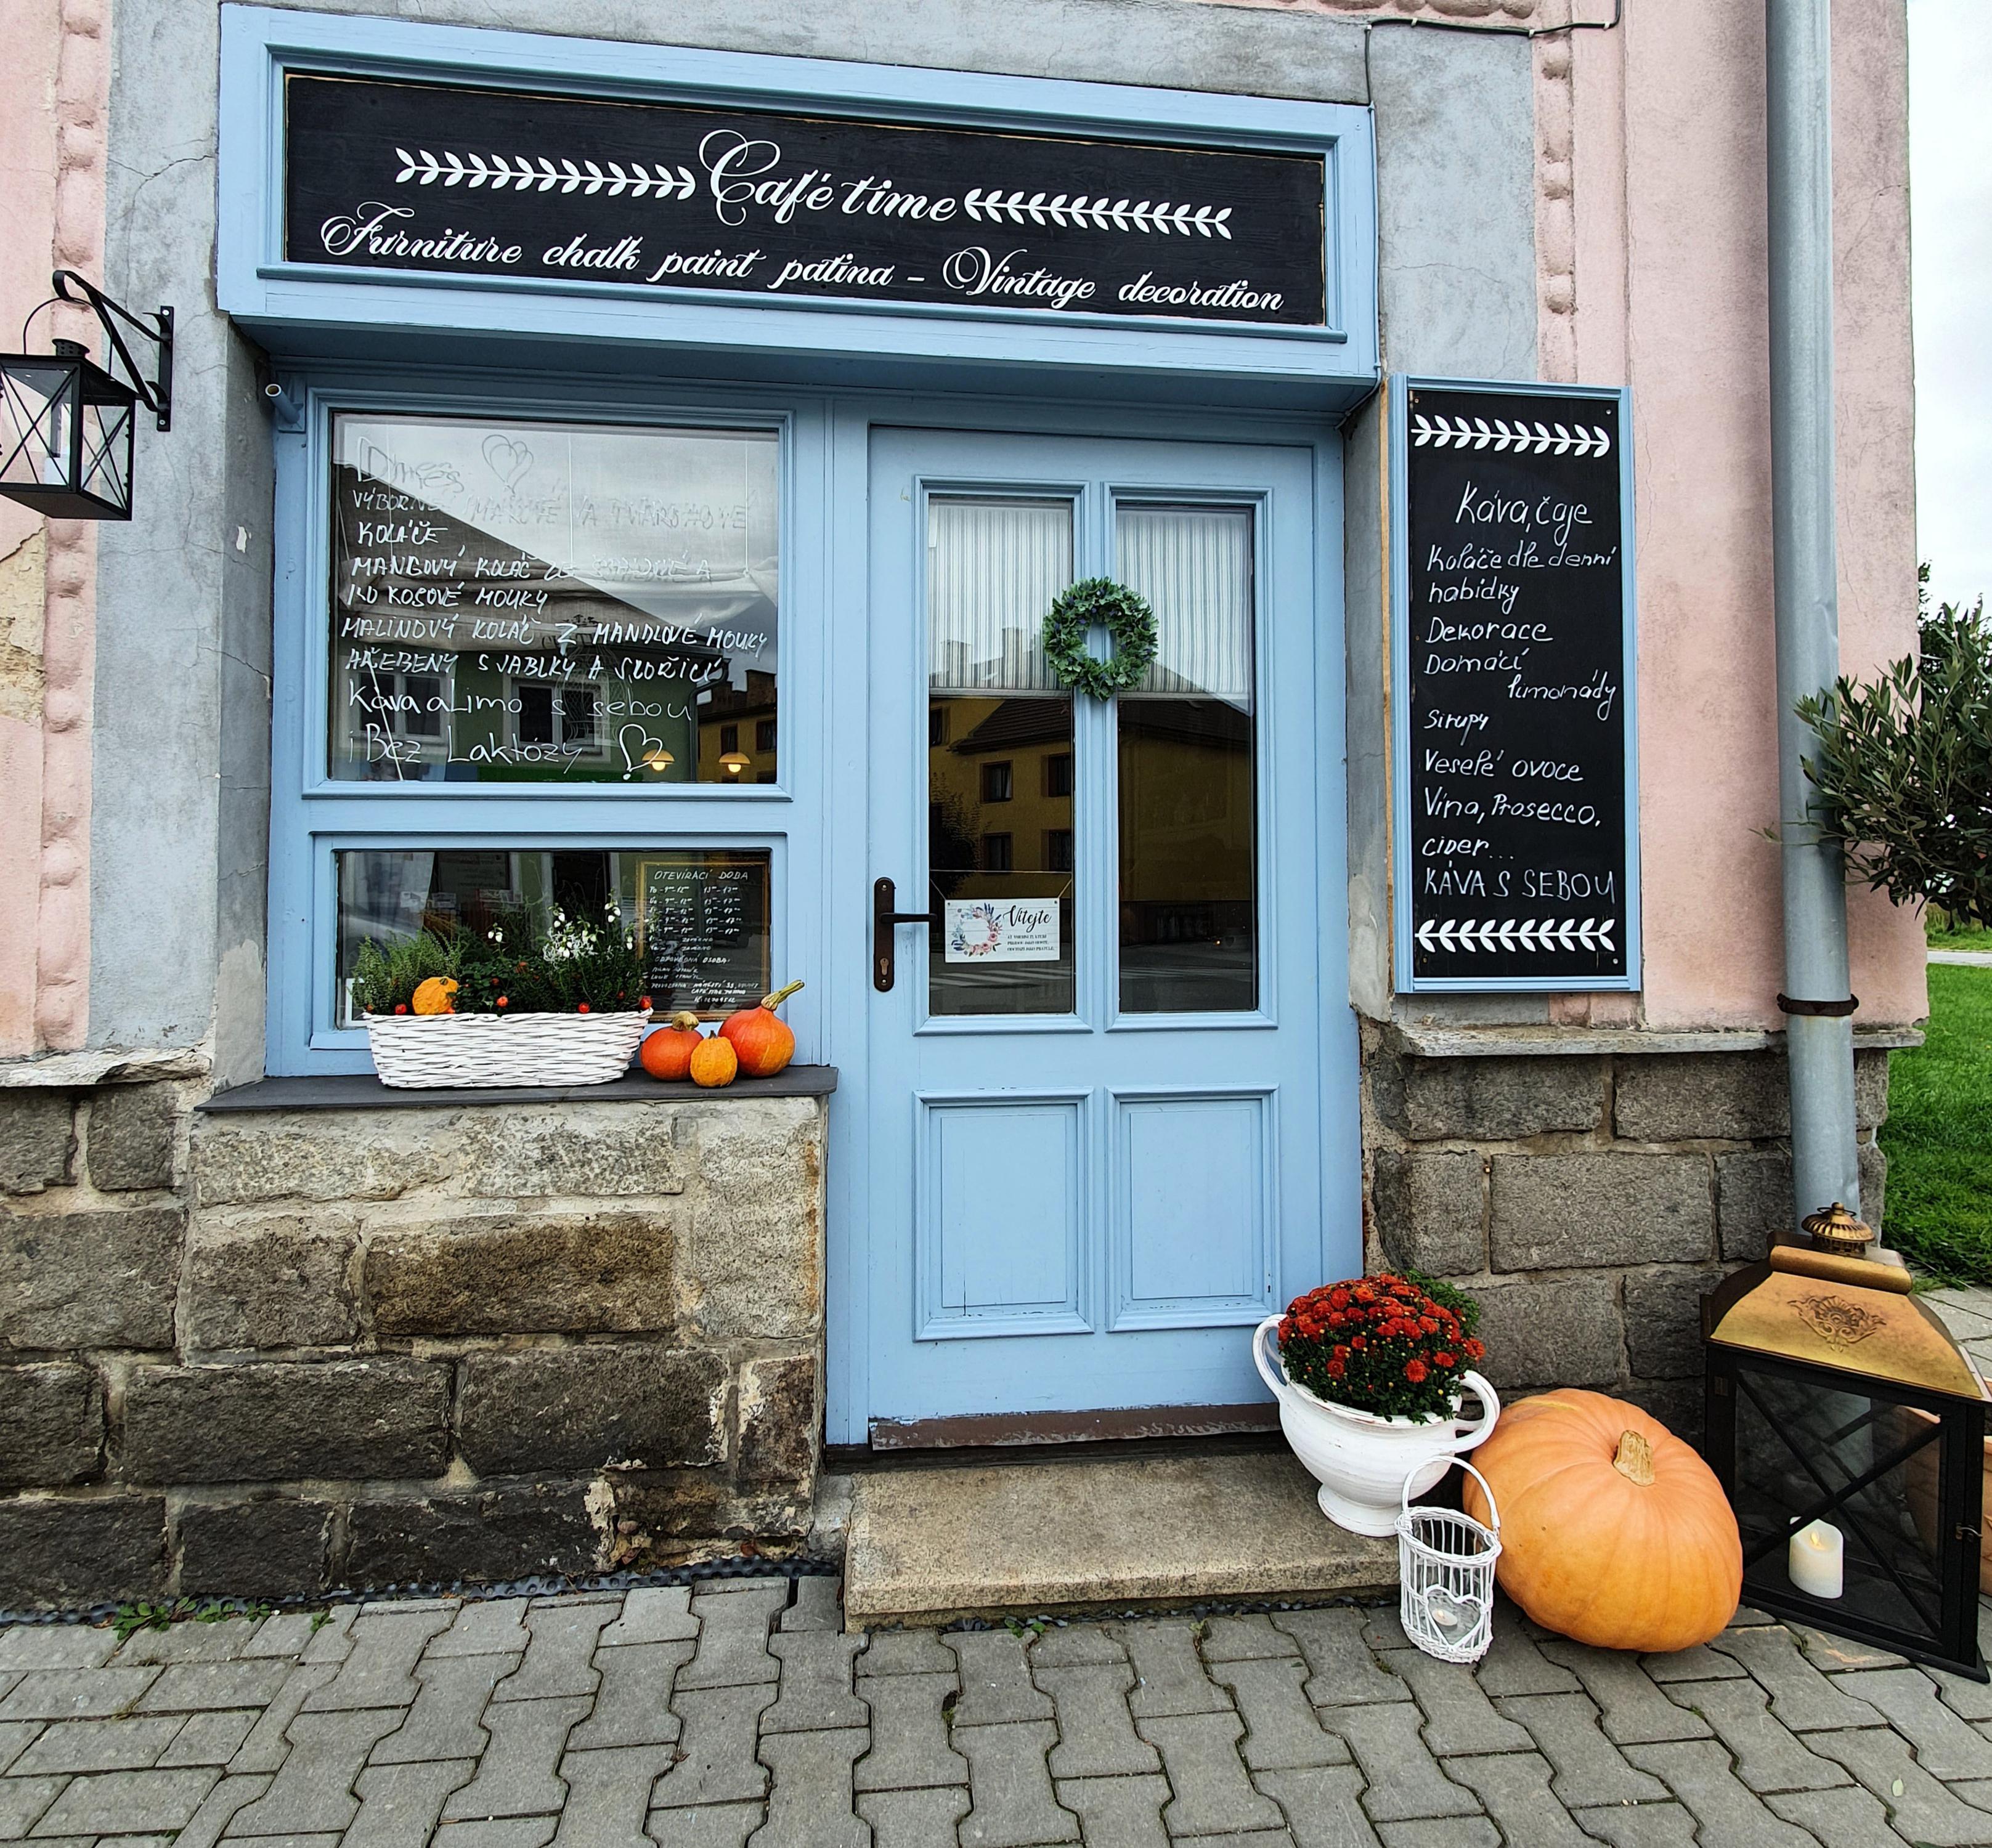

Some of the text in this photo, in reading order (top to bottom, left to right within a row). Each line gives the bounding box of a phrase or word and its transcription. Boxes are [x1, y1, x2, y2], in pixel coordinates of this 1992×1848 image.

[699, 129, 957, 226] Café time
[320, 201, 522, 264] Furniture
[542, 233, 644, 270] chalk
[646, 248, 768, 283] paint
[767, 252, 894, 290] patina
[943, 246, 1096, 310] Vintage
[1118, 271, 1285, 310] decoration
[351, 545, 466, 577] MANGOVÝ
[1426, 539, 1617, 572] Koláče dle denní
[474, 586, 550, 615] MOUKY
[1428, 576, 1520, 615] nabídky
[592, 612, 704, 646] MANDLOVÉ
[705, 626, 768, 660] MOUKY
[1425, 616, 1554, 644] Dekorace
[1423, 647, 1531, 675] Domácí
[587, 686, 692, 721] sebou
[1423, 709, 1489, 746] Sirupy
[365, 723, 422, 764] Bez
[447, 724, 583, 775] Laktózy
[1425, 748, 1584, 782] Veselé ovoce
[1425, 785, 1486, 825] Vína,
[718, 871, 749, 881] DOBA
[1424, 859, 1616, 904] KÁVA S SEBOU
